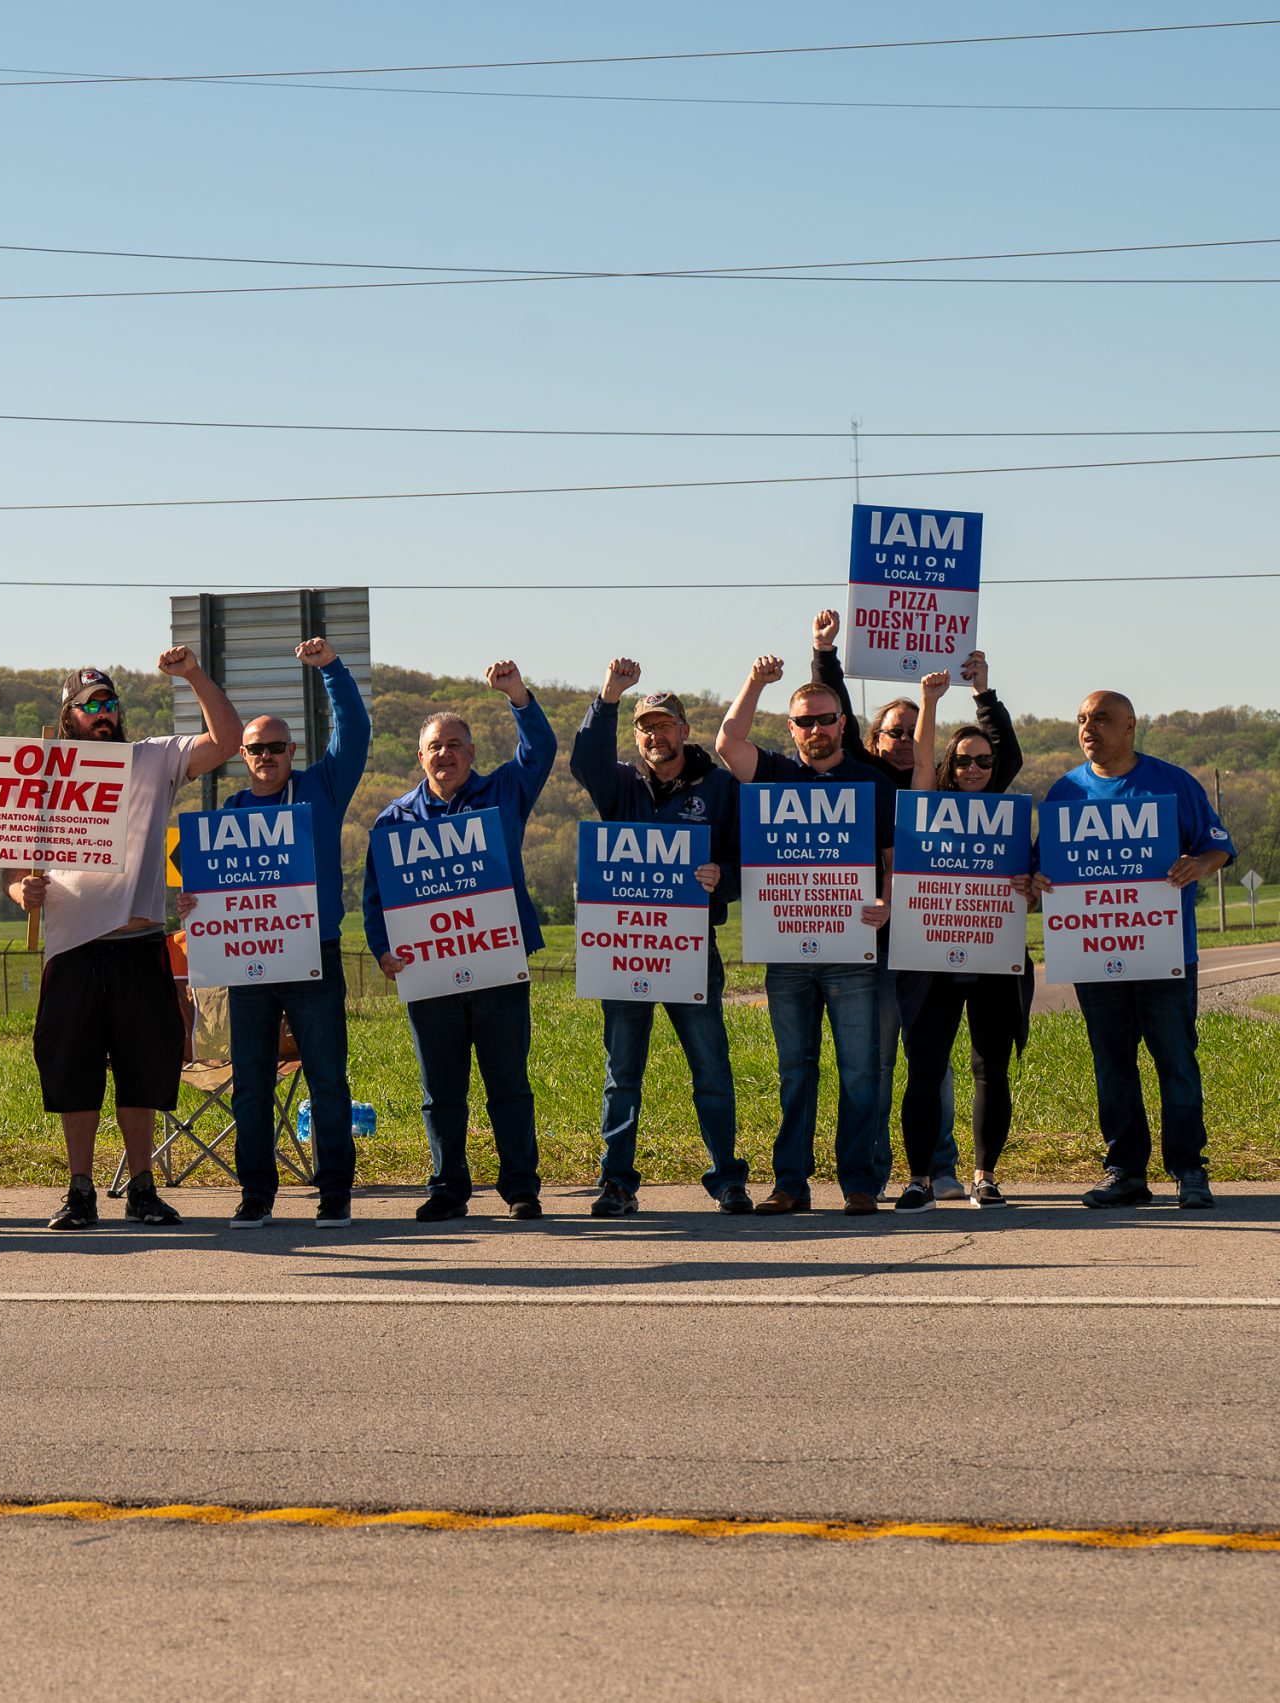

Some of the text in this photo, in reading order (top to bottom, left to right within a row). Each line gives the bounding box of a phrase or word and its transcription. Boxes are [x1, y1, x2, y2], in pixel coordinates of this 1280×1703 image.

[870, 512, 964, 550] IAM
[876, 553, 955, 568] UNION
[885, 569, 945, 582] LOCAL 778
[889, 590, 938, 611] PIZZA
[855, 609, 970, 634] DOESN'T PAY
[869, 630, 956, 653] THE BILLS
[14, 745, 77, 777] ON
[760, 789, 855, 824] IAM
[50, 815, 109, 825] ASSOCIATION
[916, 797, 1014, 835] IAM
[1059, 803, 1158, 842] IAM
[9, 825, 65, 833] MACHINISTS
[68, 827, 87, 835] AND
[199, 811, 294, 851] IAM
[767, 832, 849, 843] UNION
[25, 836, 73, 846] WORKERS,
[76, 838, 112, 846] AFL-CIO
[389, 817, 487, 866] IAM
[597, 828, 690, 864] IAM
[922, 841, 1004, 854] UNION
[23, 848, 77, 863] LODGE
[83, 852, 111, 864] 778
[777, 849, 839, 858] LOCAL 778
[1068, 847, 1152, 861] UNION
[208, 854, 289, 870] UNION
[931, 858, 993, 869] LOCAL 778
[1079, 864, 1142, 876] LOCAL 778
[219, 870, 280, 884] LOCAL 778
[403, 860, 483, 884] UNION
[603, 871, 683, 884] UNION
[767, 872, 859, 886] HIGHLY SKILLED
[416, 878, 476, 897] LOCAL 778
[613, 887, 673, 898] LOCAL 778
[759, 888, 862, 902] HIGHLY ESSENTIAL
[918, 881, 1012, 897] HIGHLY SKILLED
[226, 893, 277, 912] FAIR
[908, 895, 1015, 913] HIGHLY ESSENTIAL
[1085, 888, 1138, 906] FAIR
[617, 911, 667, 927] FAIR
[773, 904, 852, 918] OVERWORKED
[190, 912, 315, 937] CONTRACT
[430, 908, 475, 933] ON
[778, 920, 845, 933] UNDERPAID
[923, 913, 1002, 929] OVERWORKED
[1048, 910, 1178, 931] CONTRACT
[581, 932, 704, 951] CONTRACT
[926, 929, 994, 944] UNDERPAID
[1083, 935, 1144, 952] NOW!
[225, 938, 284, 957] NOW!
[396, 926, 518, 965] STRIKE!
[612, 956, 670, 973] NOW!
